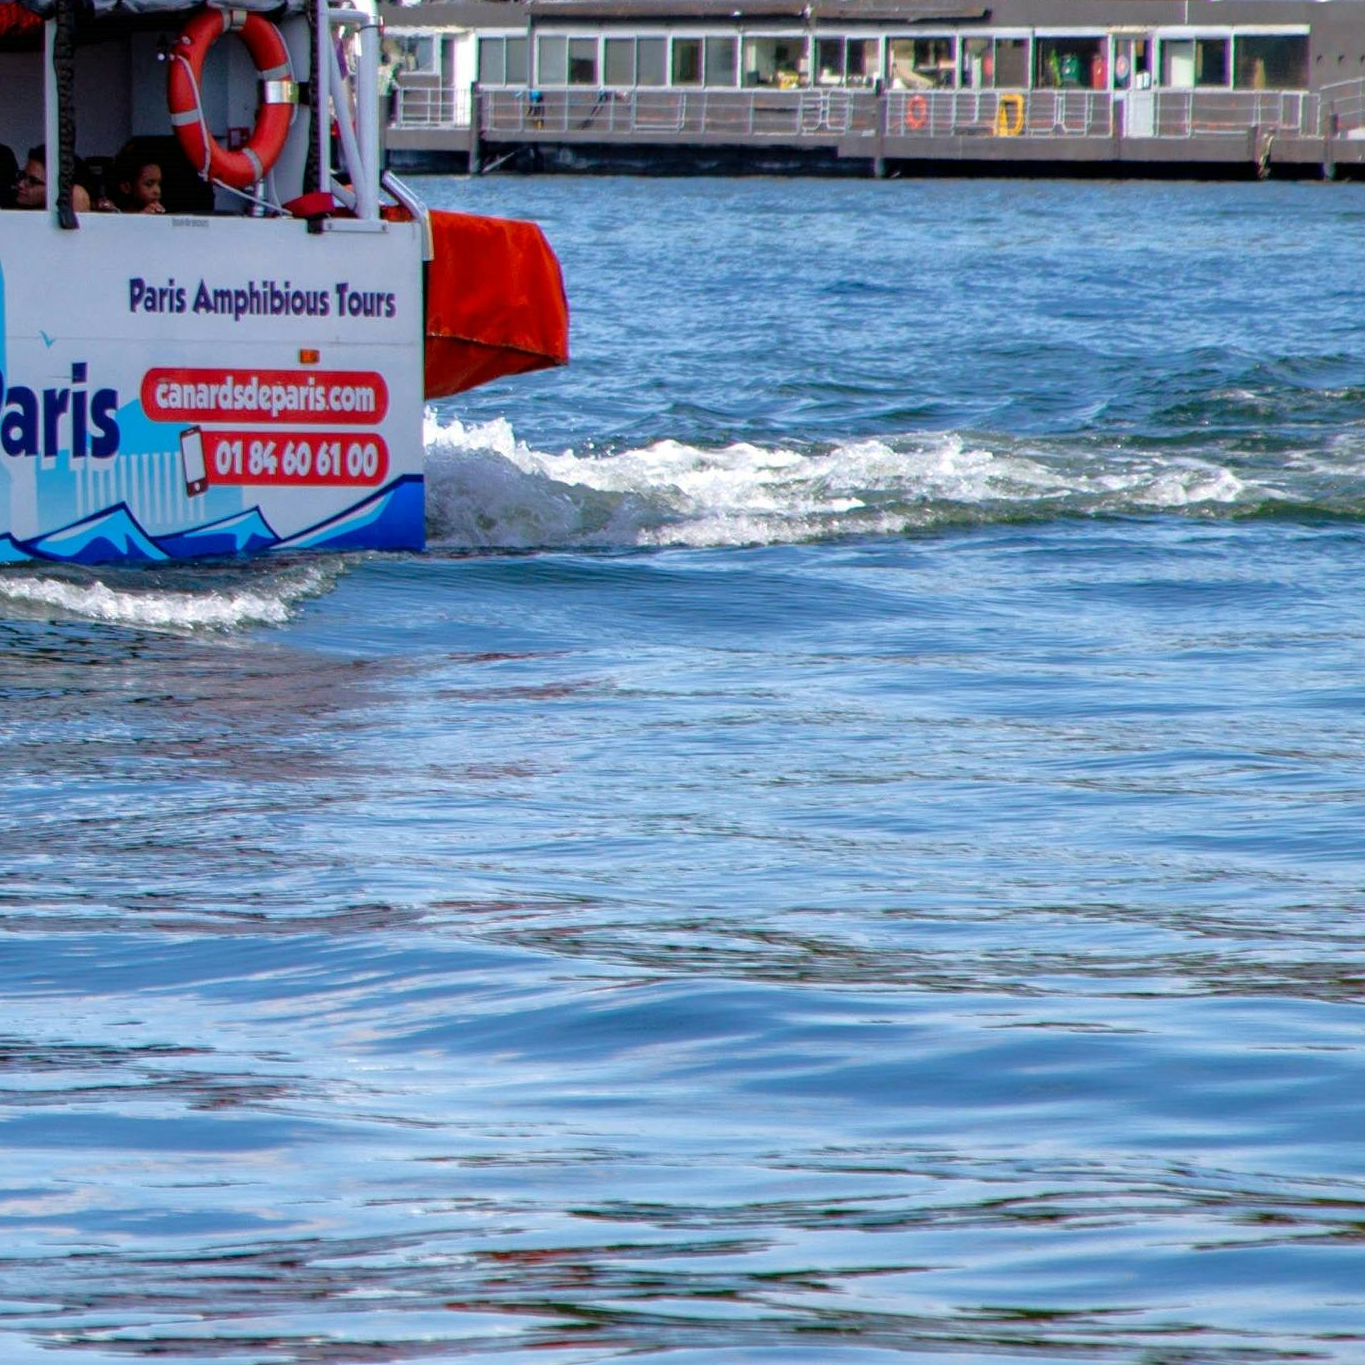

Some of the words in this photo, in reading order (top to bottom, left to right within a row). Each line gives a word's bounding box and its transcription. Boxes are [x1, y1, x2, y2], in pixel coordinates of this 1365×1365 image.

[129, 278, 187, 314] Paris
[192, 279, 331, 322] Amphibious
[335, 282, 397, 318] Tours
[156, 376, 376, 418] canardsdeparis.com
[216, 440, 243, 475] 01
[249, 440, 278, 475] 84
[282, 441, 312, 476] 60
[316, 442, 342, 476] 61
[347, 442, 379, 477] 00
